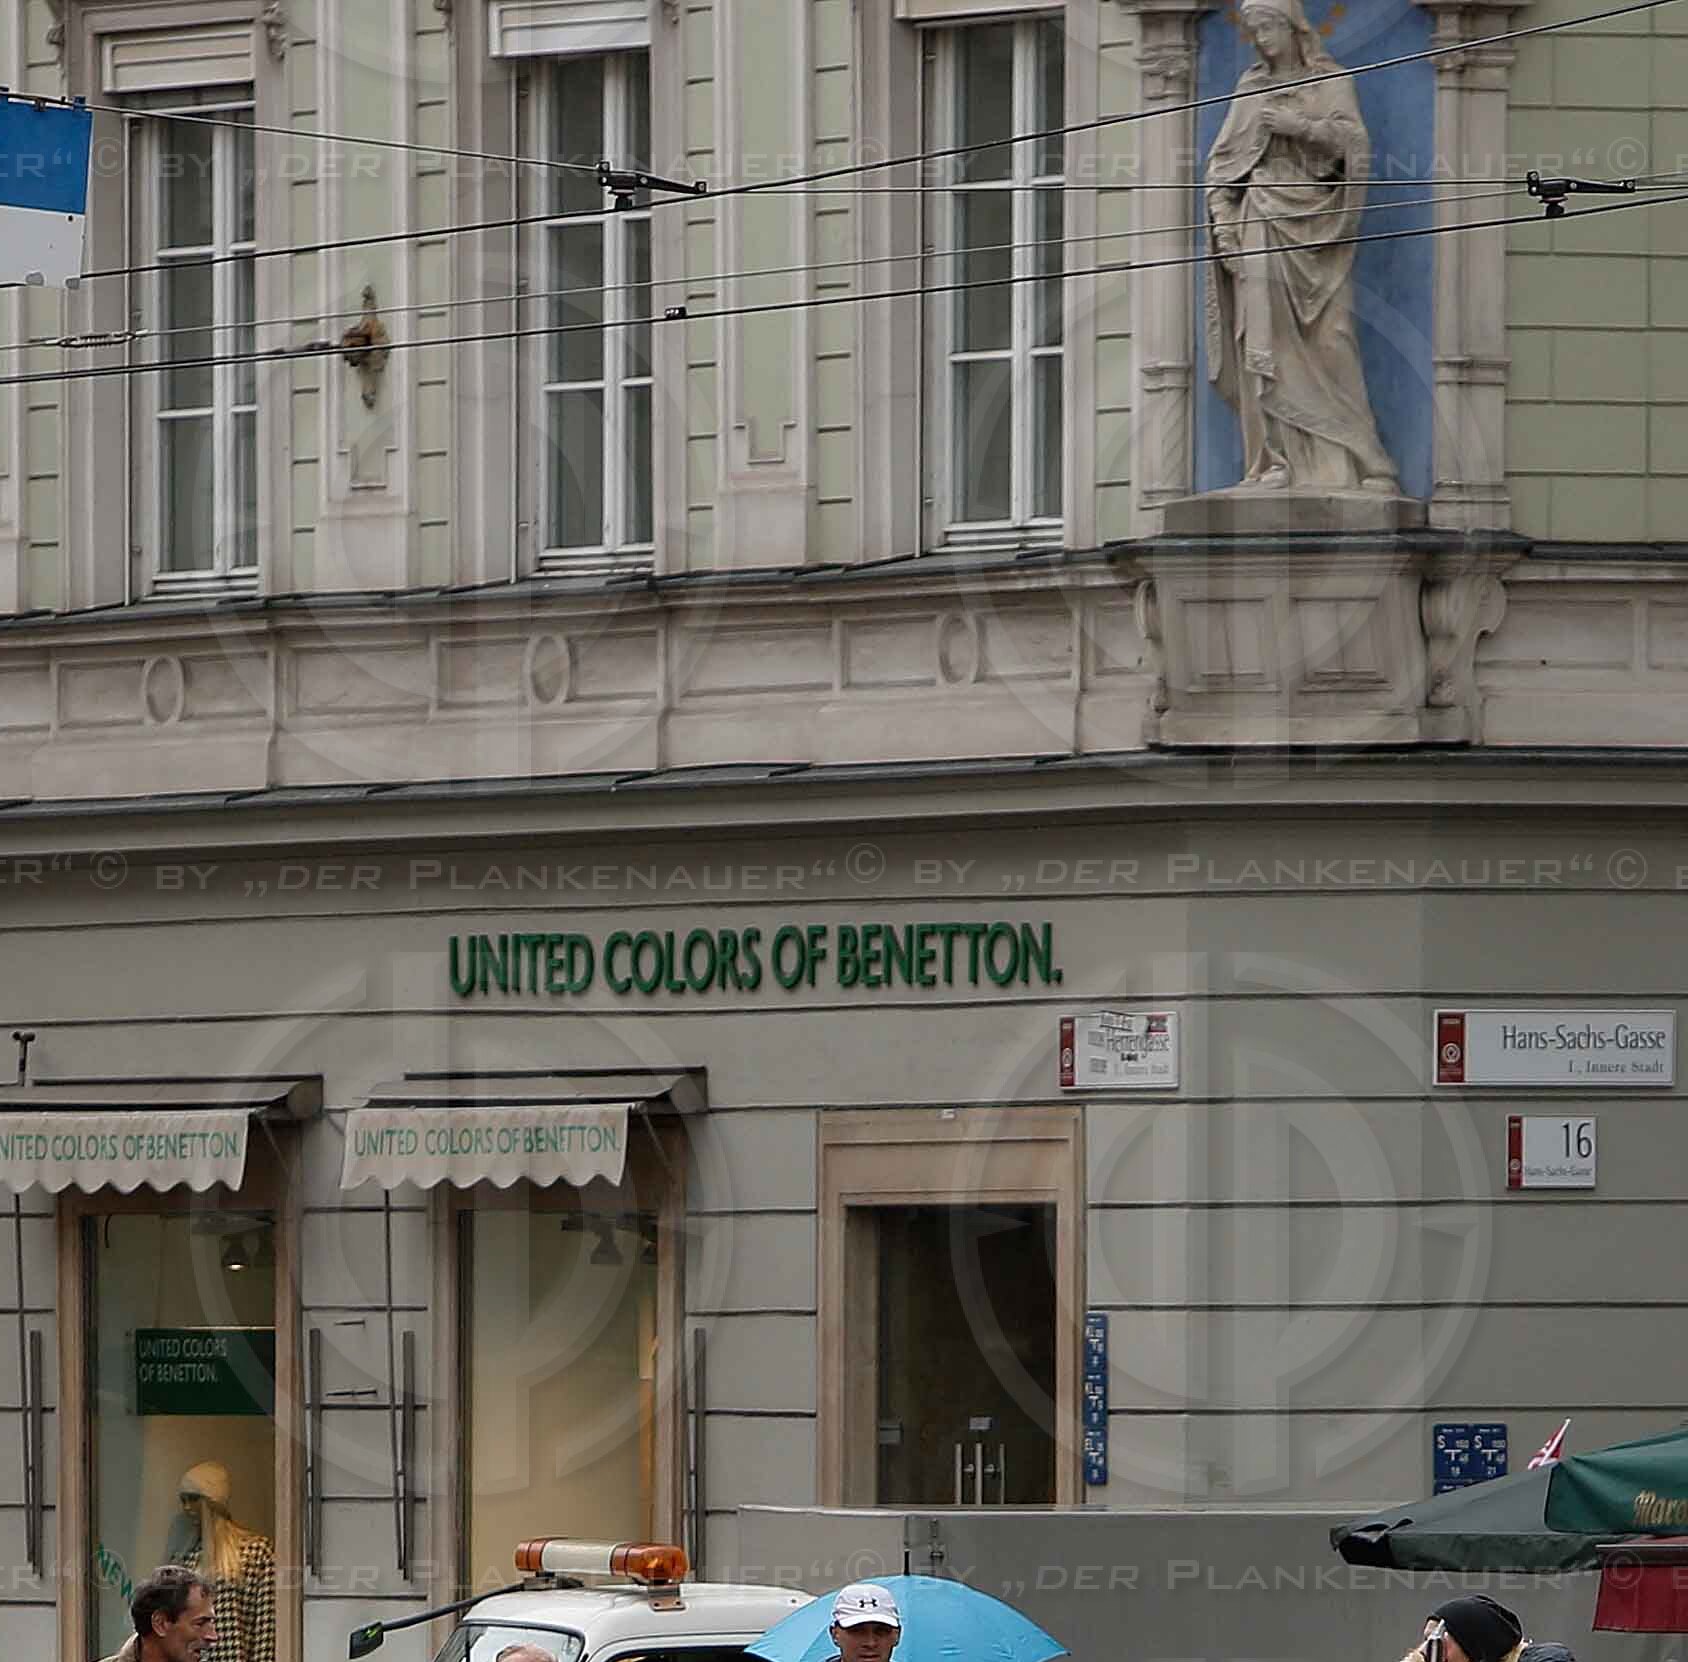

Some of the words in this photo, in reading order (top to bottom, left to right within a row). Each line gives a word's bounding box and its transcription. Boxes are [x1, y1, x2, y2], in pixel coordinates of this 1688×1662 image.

[449, 932, 594, 996] UNITED
[604, 926, 762, 995] COLORS
[771, 926, 828, 988] OF
[836, 921, 1064, 988] BENETTON.
[1502, 1024, 1666, 1050] Hans-Sachs-Gasse
[51, 1134, 116, 1161] COLORS
[122, 1135, 144, 1161] OF
[354, 1127, 416, 1157] UNITED
[424, 1127, 492, 1156] COLORS
[497, 1127, 521, 1154] OF
[1562, 1122, 1593, 1159] 16
